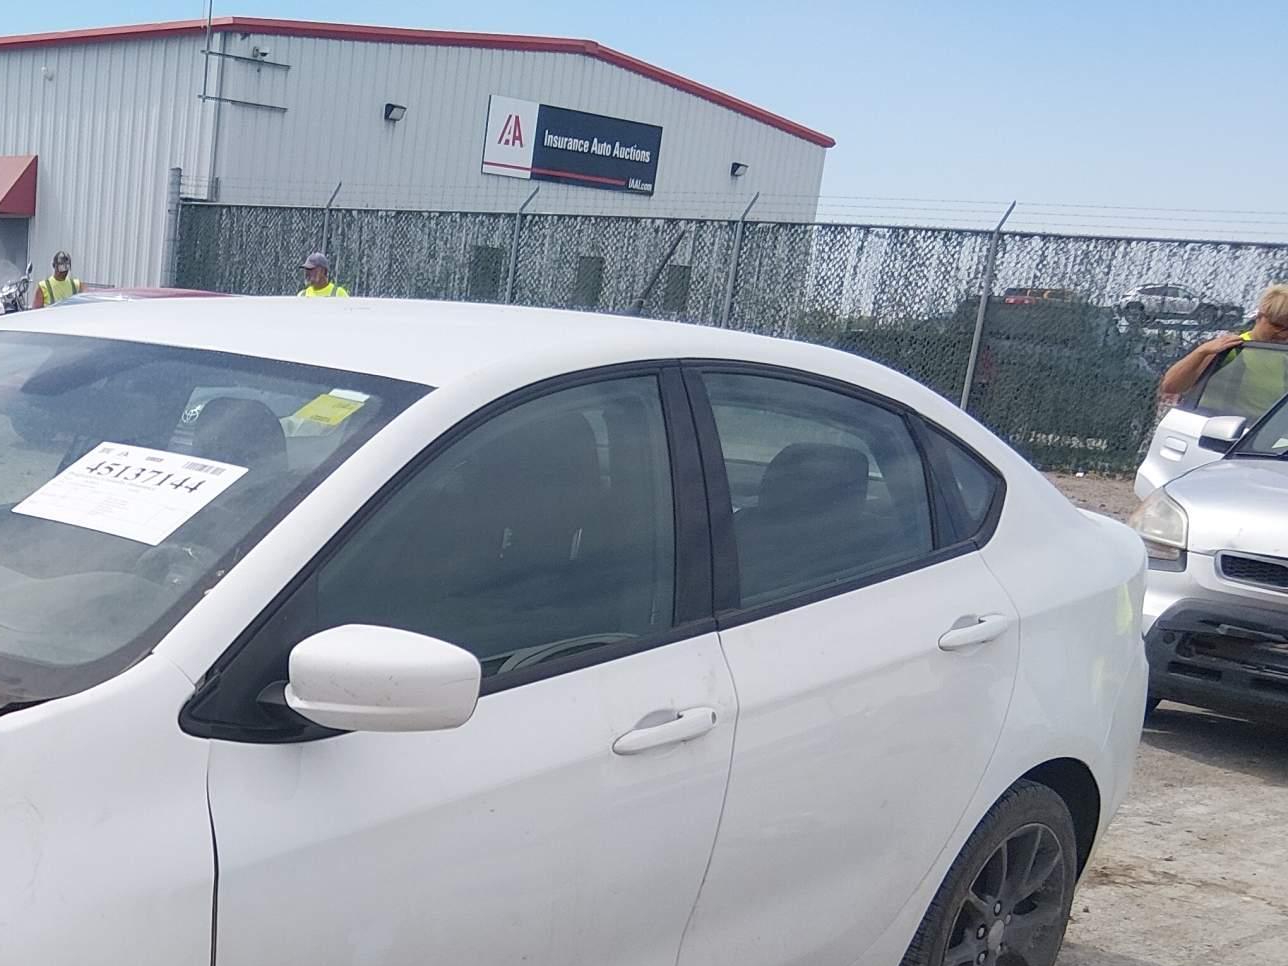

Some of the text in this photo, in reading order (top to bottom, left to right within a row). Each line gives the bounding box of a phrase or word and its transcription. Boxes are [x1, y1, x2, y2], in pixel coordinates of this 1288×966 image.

[543, 129, 651, 163] Insurance Auto Auctions
[86, 460, 207, 494] 45137144
